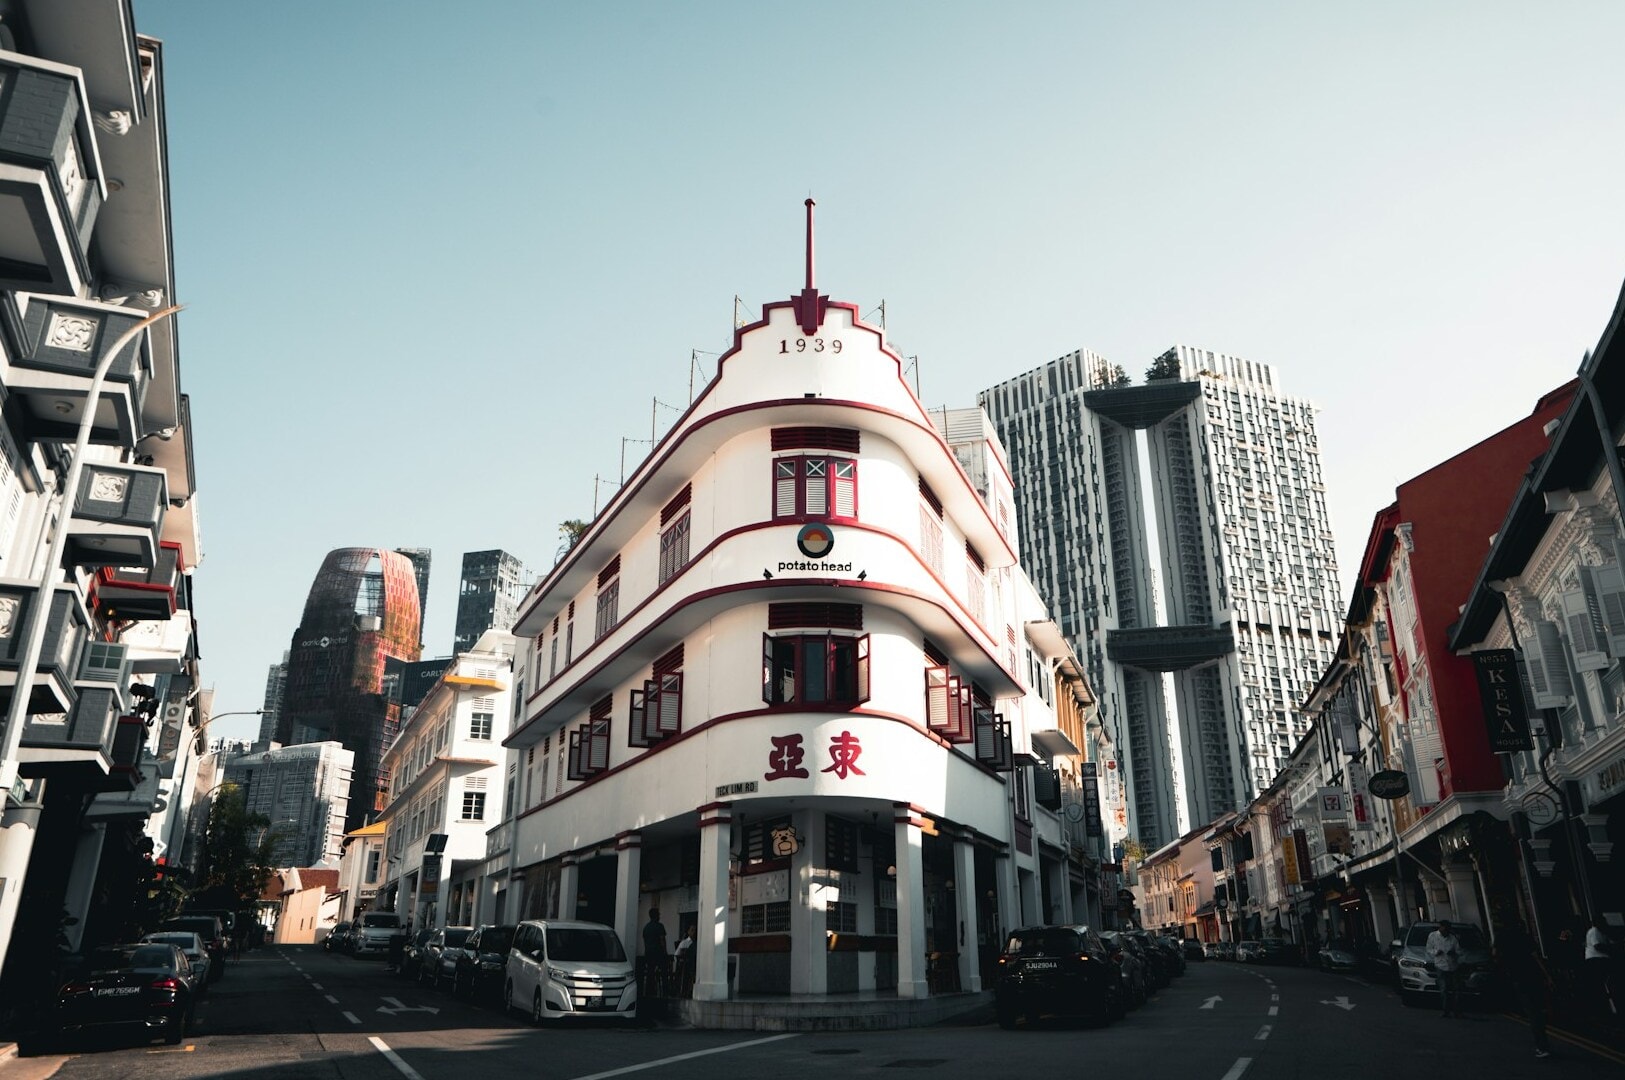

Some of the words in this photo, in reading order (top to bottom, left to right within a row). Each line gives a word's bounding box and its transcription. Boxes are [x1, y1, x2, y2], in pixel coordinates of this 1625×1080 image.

[779, 338, 843, 354] 1939
[778, 561, 819, 572] potato
[821, 561, 852, 572] head
[1488, 669, 1517, 733] KESA
[716, 785, 729, 797] TECK
[731, 783, 743, 794] LIM
[745, 782, 755, 792] RD
